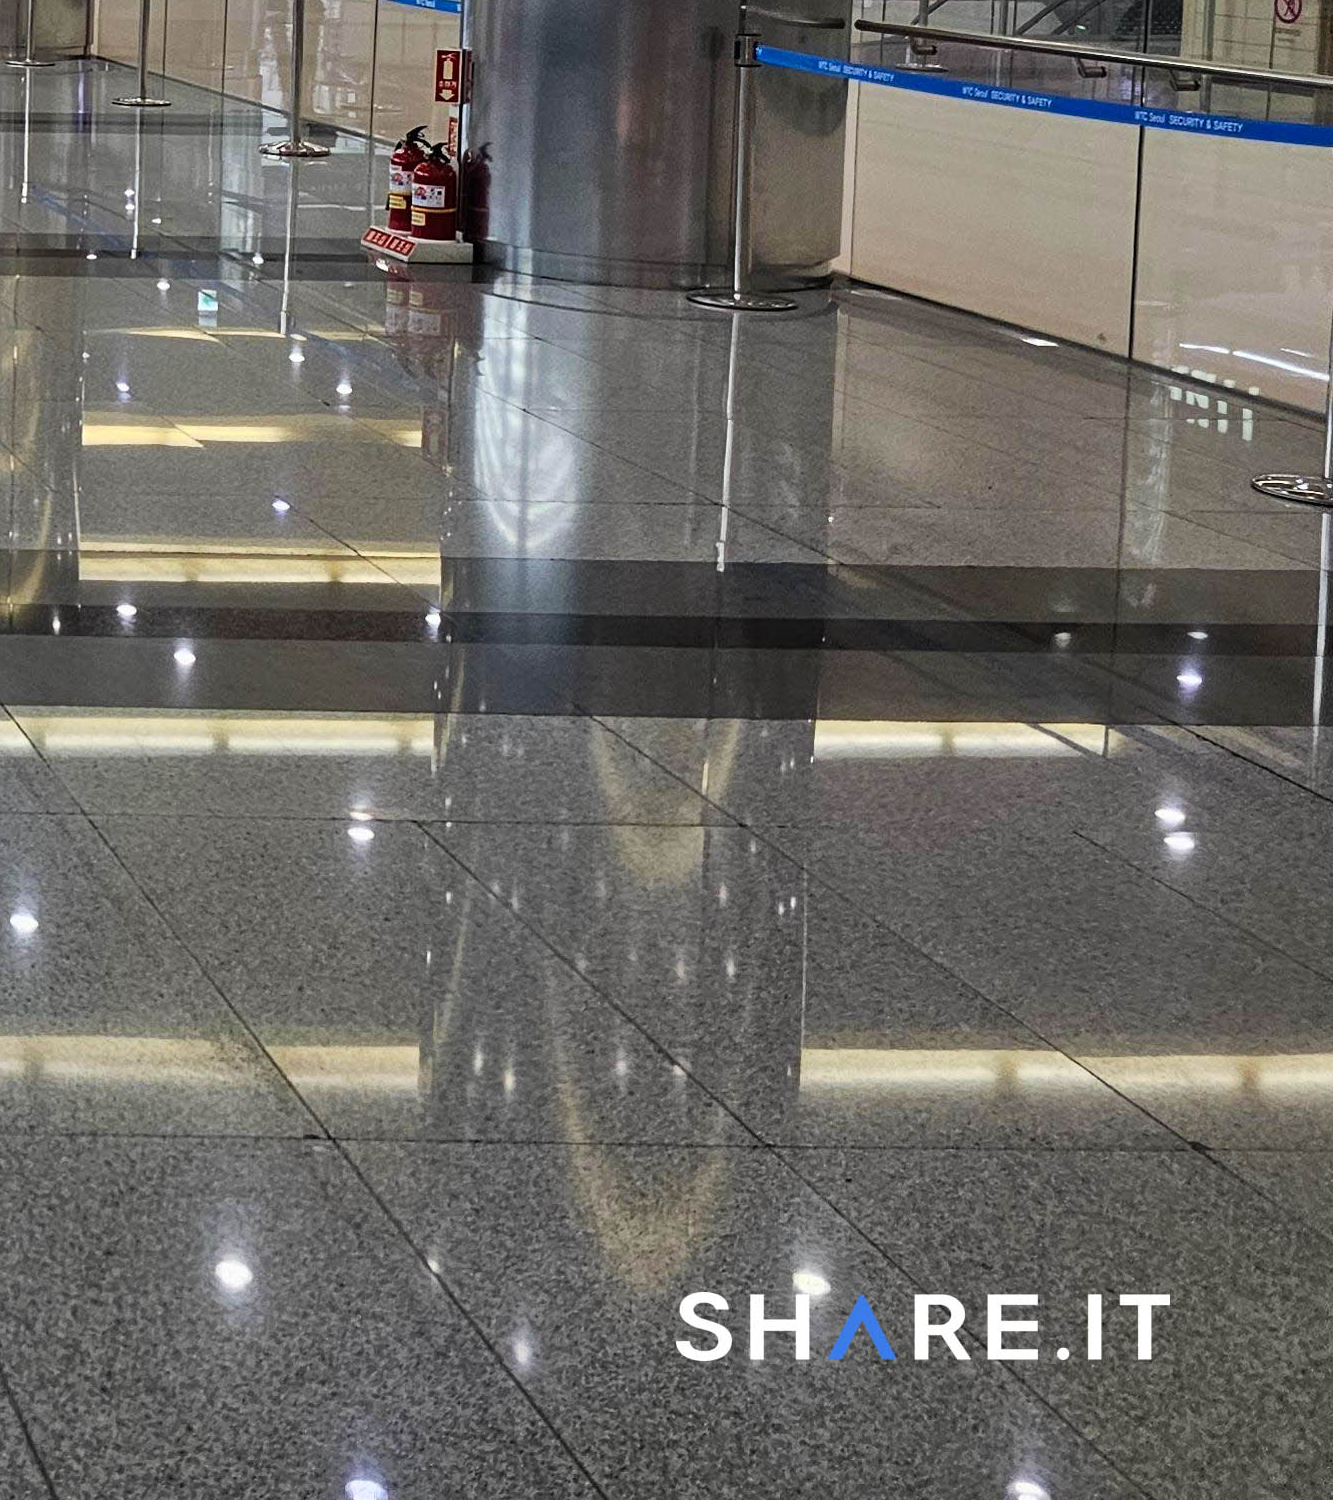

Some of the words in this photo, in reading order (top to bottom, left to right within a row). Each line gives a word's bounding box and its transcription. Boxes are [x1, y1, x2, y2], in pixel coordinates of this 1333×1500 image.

[843, 64, 868, 77] SECURITY
[873, 70, 895, 82] SAFETY
[990, 90, 1020, 103] SECURITY
[1027, 95, 1053, 108] SAFETY
[1169, 116, 1204, 129] SECURITY
[1213, 121, 1244, 133] SAFETY
